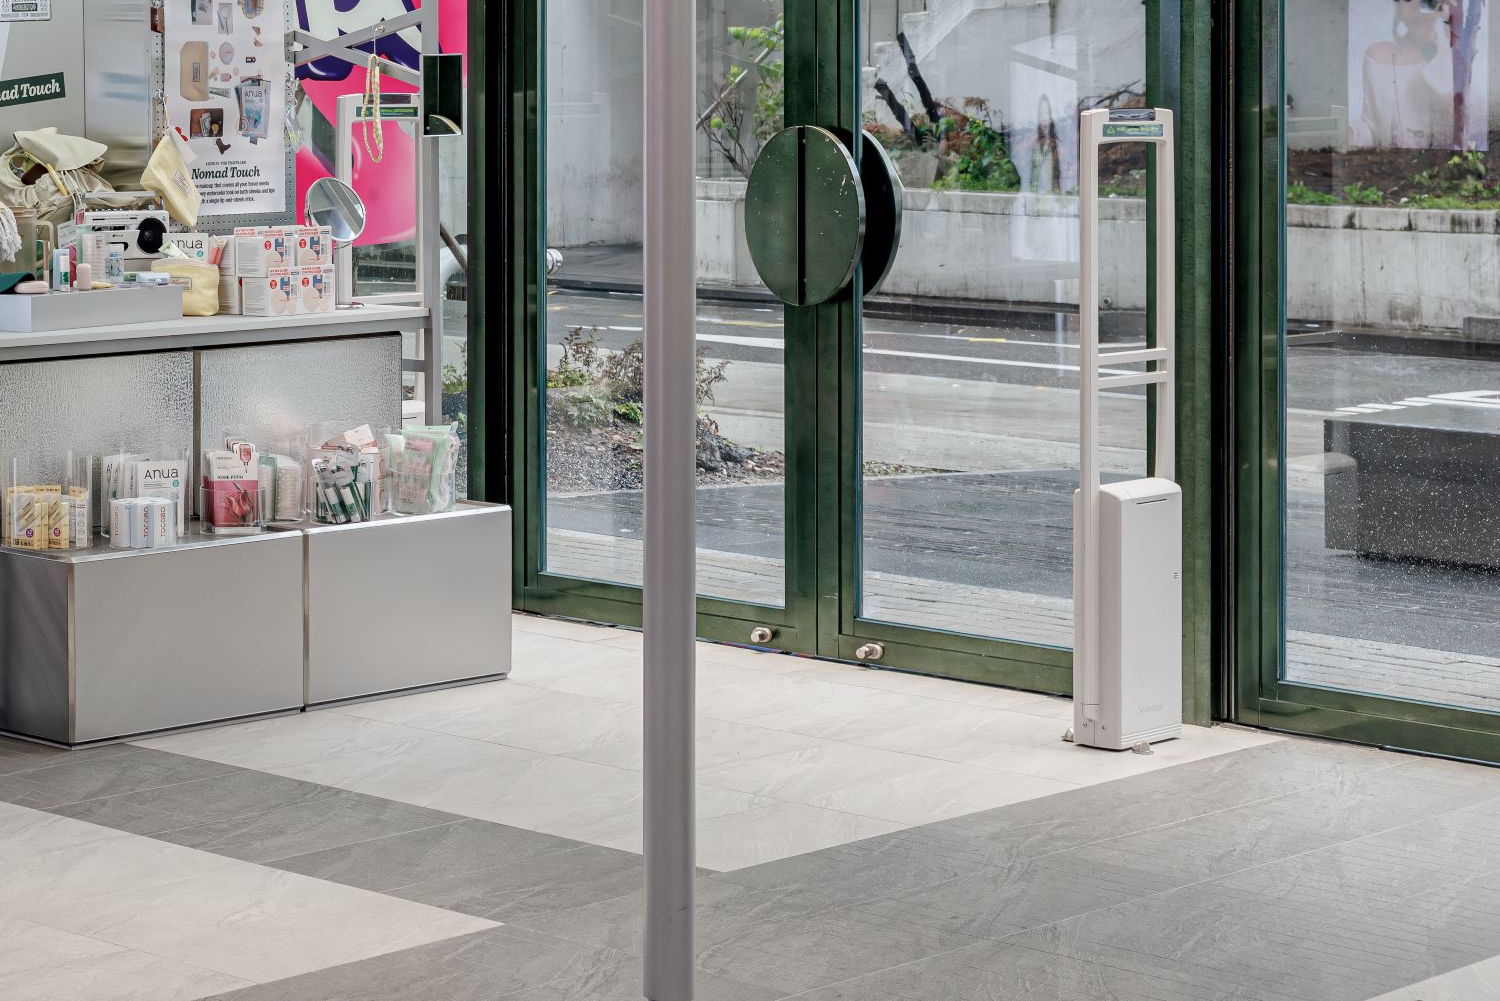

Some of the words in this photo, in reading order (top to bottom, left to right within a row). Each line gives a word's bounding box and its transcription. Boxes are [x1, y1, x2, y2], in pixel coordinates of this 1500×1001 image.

[20, 81, 60, 98] Touch
[191, 167, 228, 179] Nomad
[230, 165, 260, 178] Touch
[171, 237, 203, 249] nua
[144, 468, 178, 480] Anua
